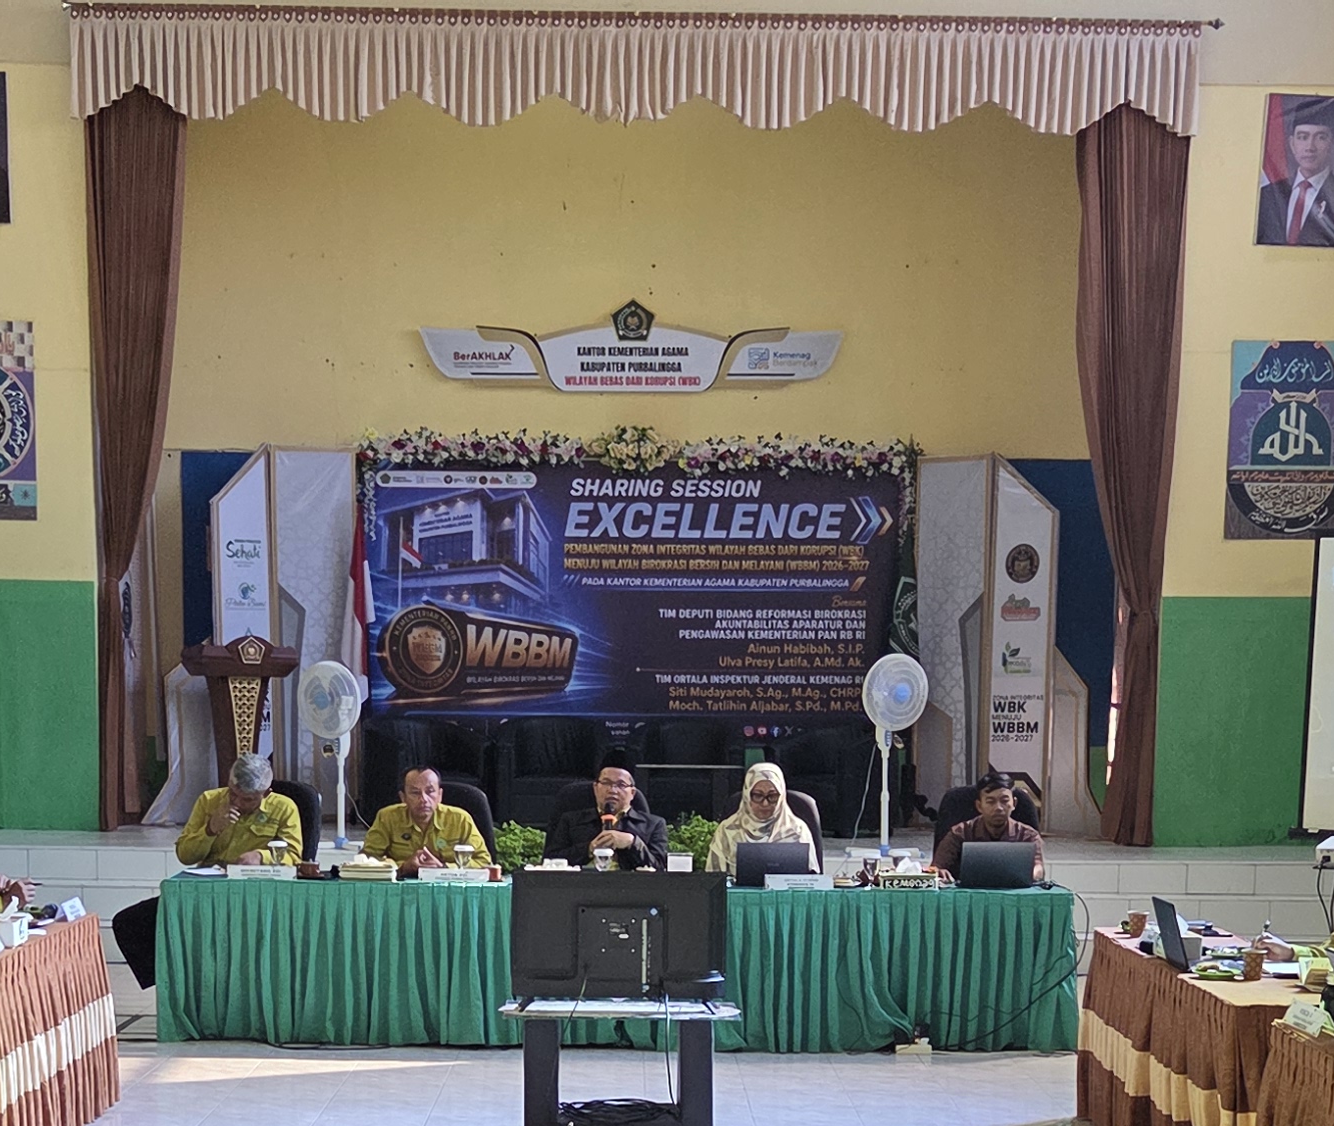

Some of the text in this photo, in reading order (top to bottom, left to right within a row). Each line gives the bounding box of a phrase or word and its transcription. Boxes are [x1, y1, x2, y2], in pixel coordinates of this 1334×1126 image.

[453, 349, 512, 361] BerAKHLAK
[577, 346, 689, 358] KANTOR KEMENTERIAN AGAMA
[773, 351, 811, 363] Kemenag
[580, 361, 682, 374] KABUPATEN PURBALINGGA
[565, 375, 598, 388] WILAYAH
[600, 375, 623, 388] BEBAS
[625, 375, 642, 388] DARI
[644, 375, 675, 388] KORUPSI
[570, 477, 763, 498] SHARING SESSION
[563, 502, 847, 540] EXCELLENCE
[225, 540, 262, 561] Sehati
[563, 543, 629, 556] PEMBANGUNAN
[631, 543, 655, 556] ZONA
[656, 543, 706, 556] INTEGRITAS
[708, 544, 747, 557] WILAYAH
[748, 544, 775, 557] BEBAS
[777, 544, 798, 557] DARI
[799, 544, 837, 557] KORUPSI
[563, 558, 600, 571] MENUJU
[601, 558, 639, 571] WILAYAH
[641, 559, 687, 572] BIROKRASI
[689, 559, 719, 572] BERSIH
[721, 559, 739, 572] DAN
[741, 559, 785, 572] MELAYANI
[786, 560, 820, 573] (WBBM)
[581, 577, 849, 589] PADA KANTOR KEMENTERIAN AGAMA KABUPATEN PURBALINGGA
[658, 608, 866, 620] TIM DEPUTI BIDANG REFORMASI BIROKRASI
[714, 619, 866, 630] AKUNTABILITAS APARATUR DAN
[678, 629, 866, 640] PENGAWASAN KEMENTERIAN PAN RB RI
[465, 623, 572, 668] WBBM
[747, 643, 865, 656] Ainun Habibah, S.I.P.
[718, 657, 743, 668] Ulva
[745, 657, 775, 670] Presy
[777, 657, 810, 669] Latifa,
[847, 658, 865, 668] Ak.
[655, 674, 672, 685] TIM
[673, 674, 708, 685] ORTALA
[710, 674, 760, 685] INSPEKTUR
[761, 674, 807, 685] JENDERAL
[809, 674, 853, 685] KEMENAG
[668, 686, 687, 697] Siti
[689, 686, 753, 700] Mudayaroh,
[755, 687, 788, 700] S.Ag.,
[792, 687, 827, 700] M.Ag.,
[668, 700, 703, 711] Moch.
[706, 700, 747, 711] Tatlihin
[794, 701, 827, 713] S.Pd.,
[993, 701, 1026, 713] WBK
[992, 721, 1038, 734] WBBM
[991, 735, 1033, 743] 2026-2027
